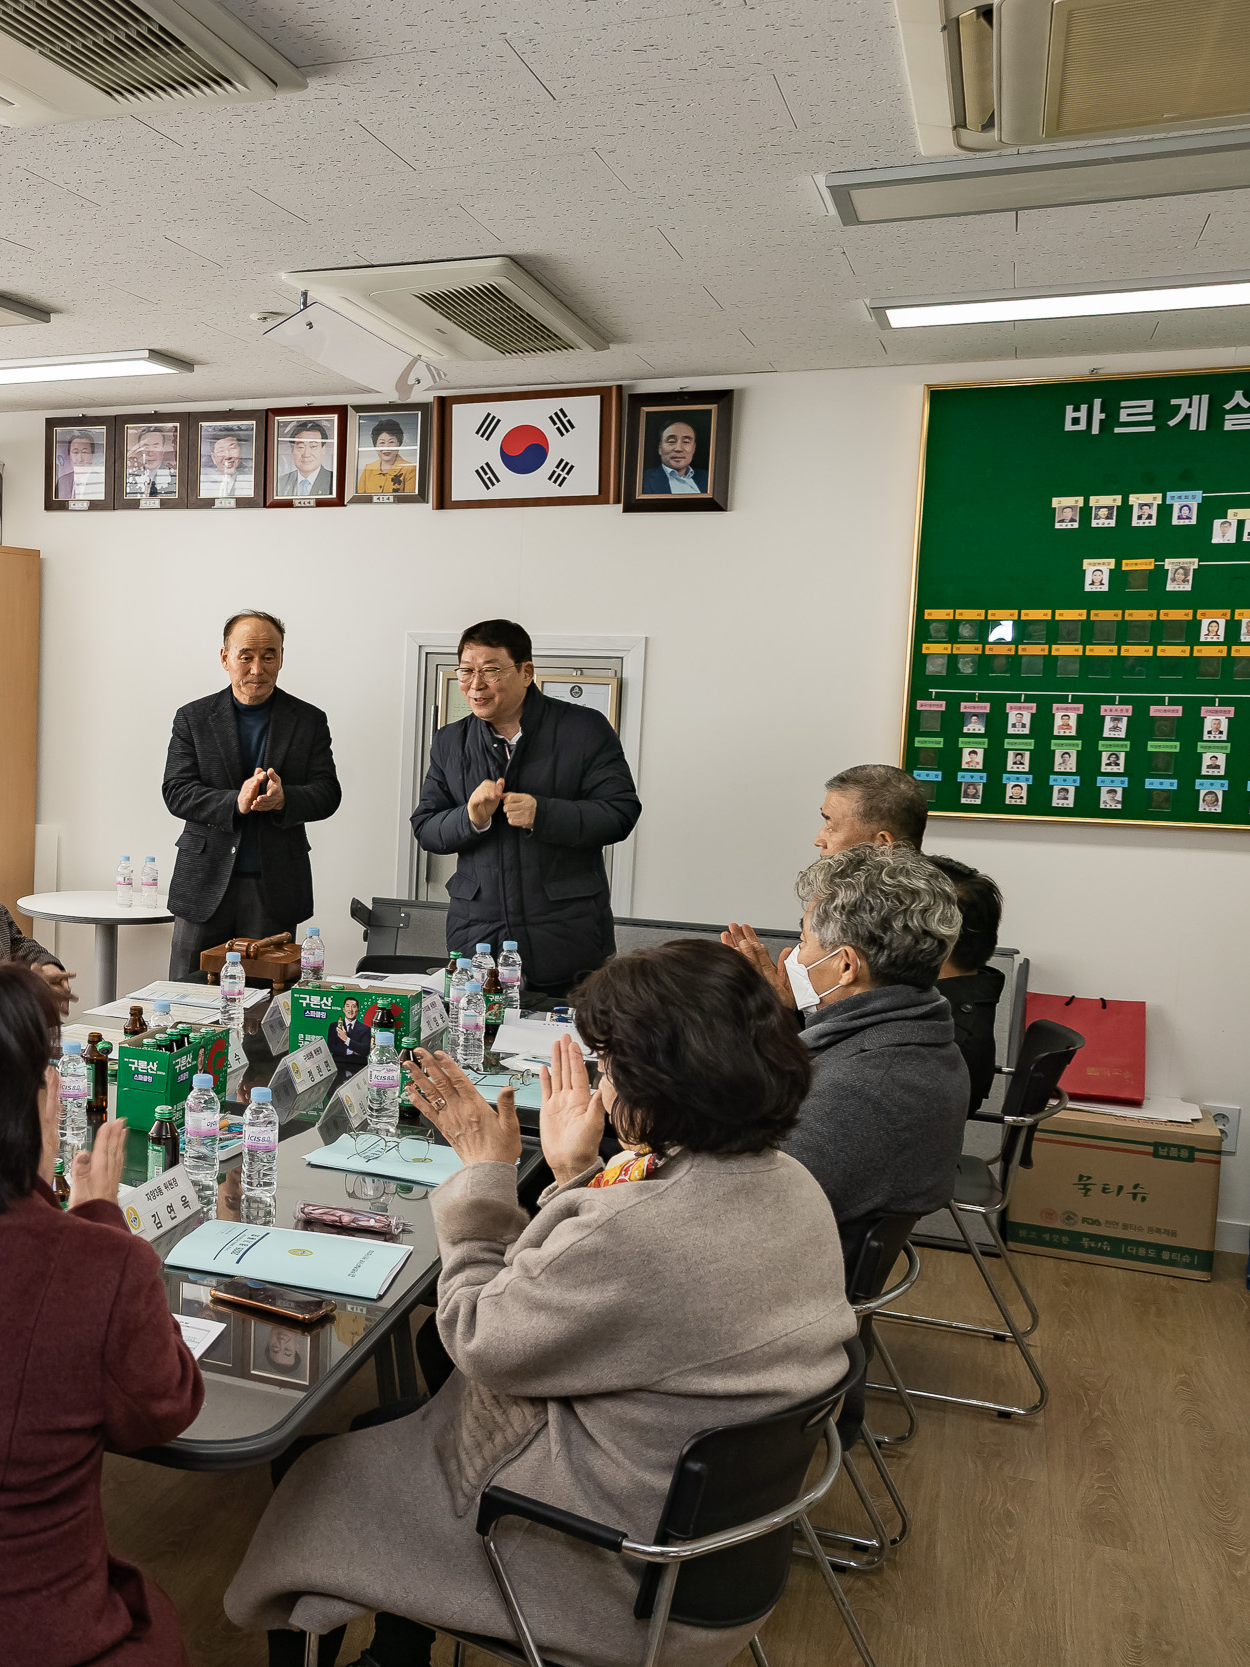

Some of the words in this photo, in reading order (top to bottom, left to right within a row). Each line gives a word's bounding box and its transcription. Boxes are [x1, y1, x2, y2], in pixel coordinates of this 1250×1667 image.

[299, 994, 334, 1010] 구론산
[304, 1010, 327, 1019] 스파클링
[128, 1058, 159, 1075] 구론산
[175, 1052, 194, 1073] 구론산
[133, 1073, 153, 1083] 스파클링
[163, 1177, 179, 1191] 위원장
[1071, 1173, 1151, 1203] 물티슈
